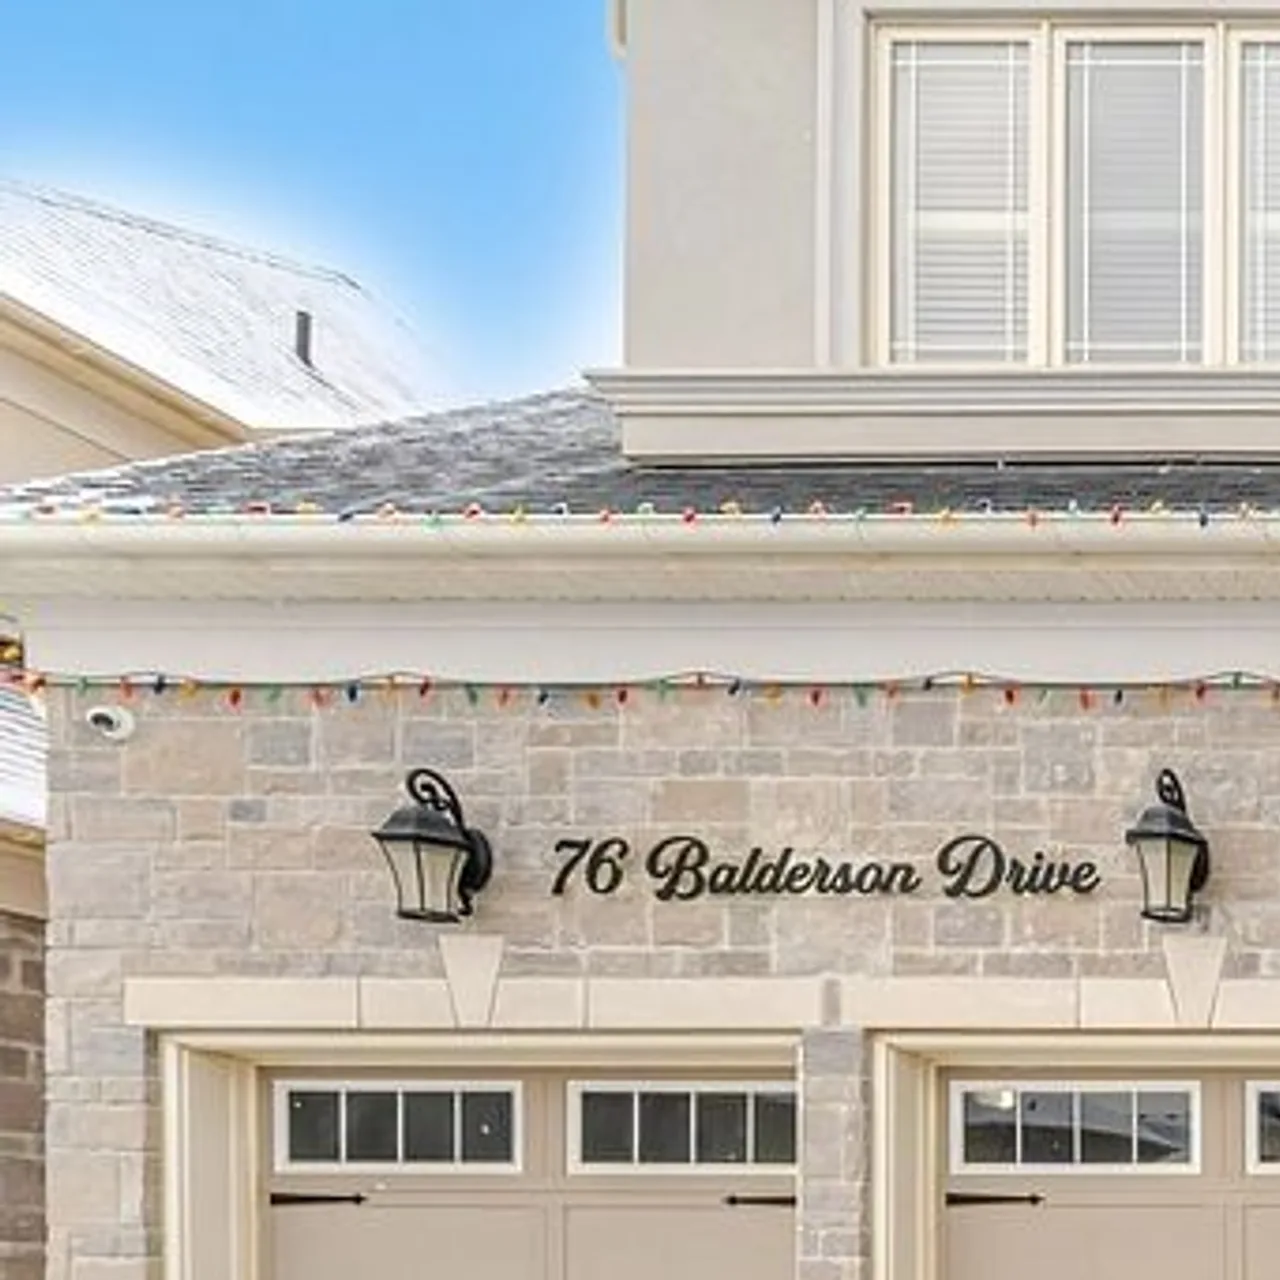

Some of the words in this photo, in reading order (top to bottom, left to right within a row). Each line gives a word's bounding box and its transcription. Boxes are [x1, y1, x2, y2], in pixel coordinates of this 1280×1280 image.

[551, 837, 631, 897] 76
[646, 835, 924, 902] Balderson
[937, 834, 1101, 900] Drive
